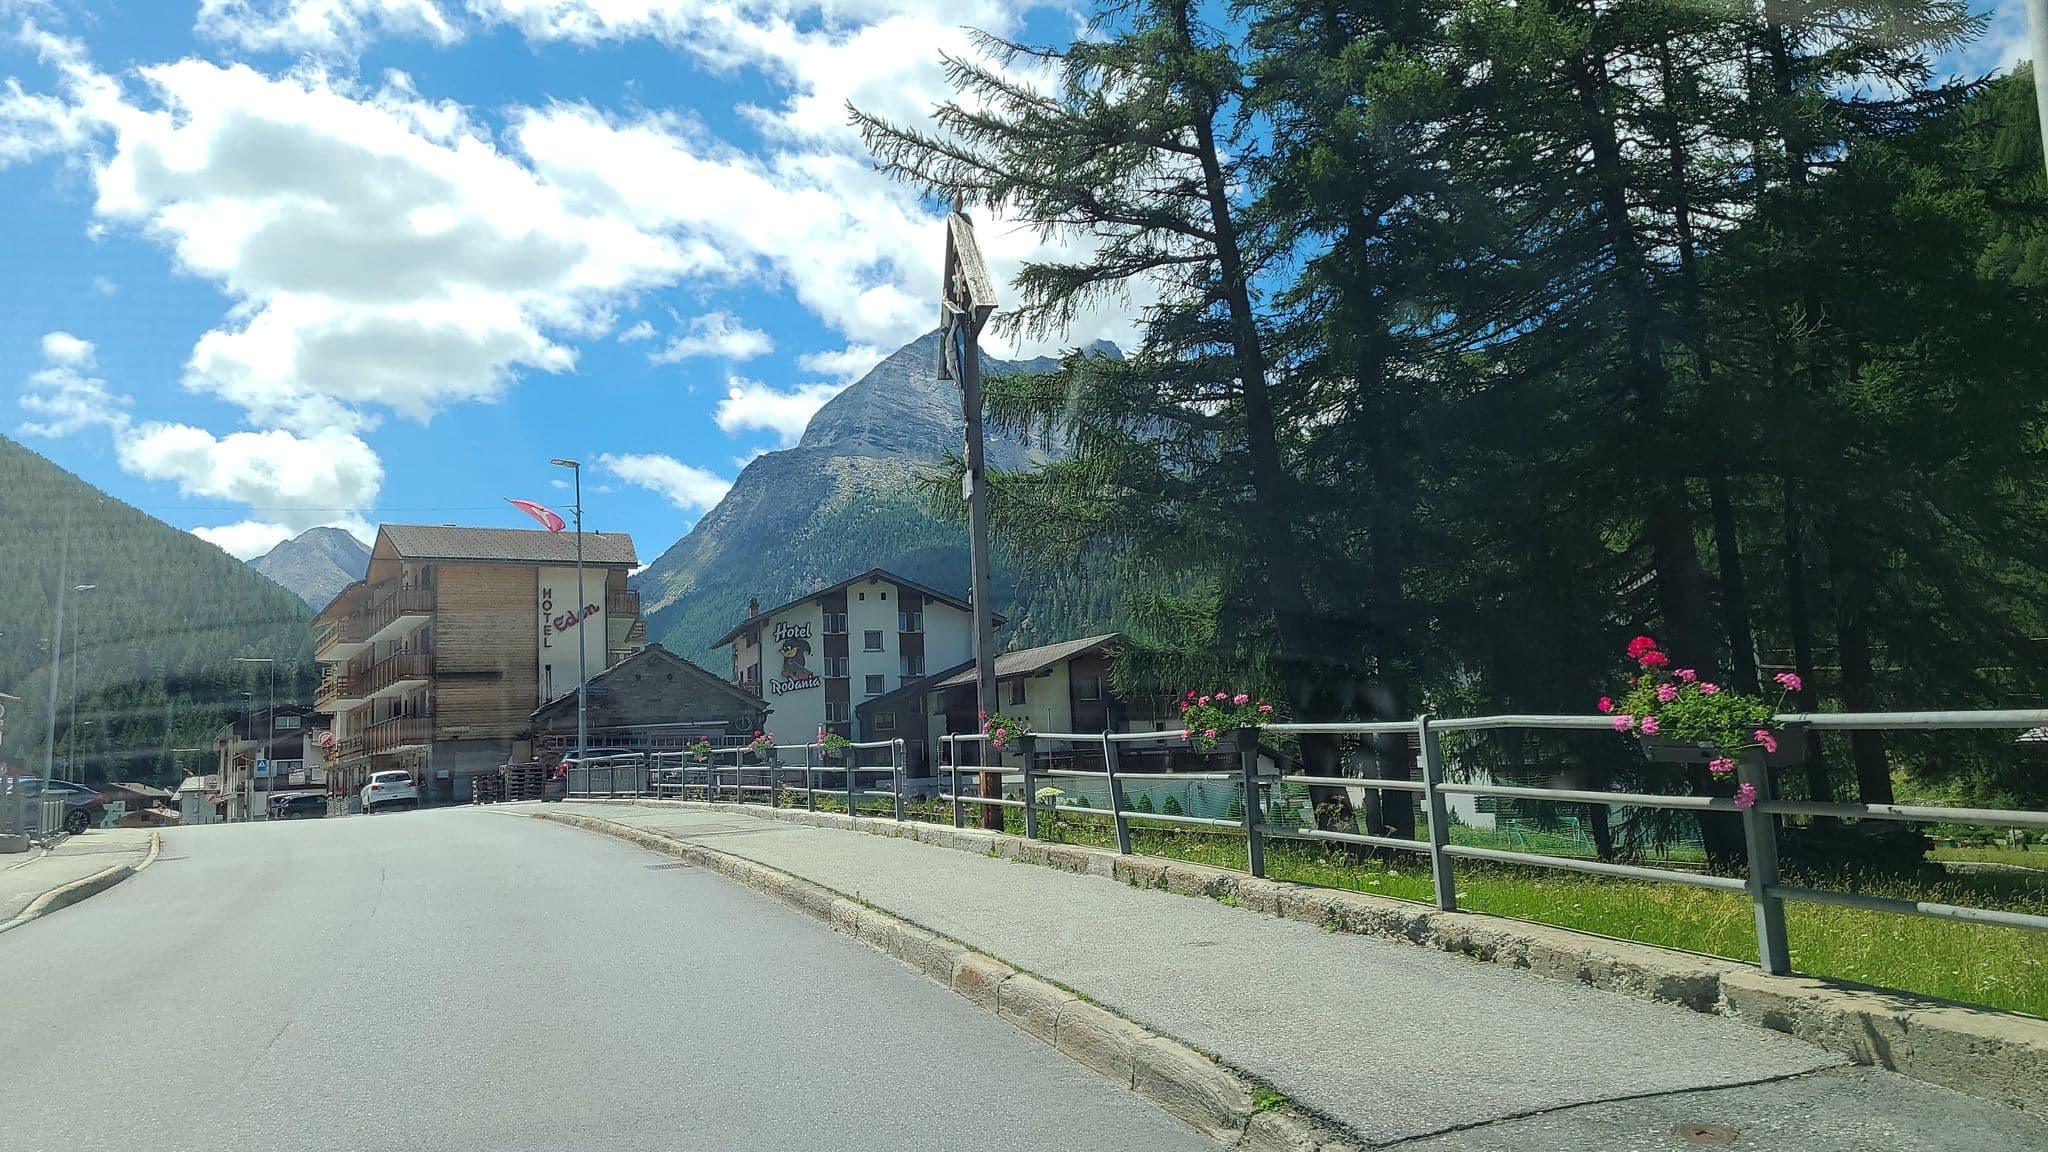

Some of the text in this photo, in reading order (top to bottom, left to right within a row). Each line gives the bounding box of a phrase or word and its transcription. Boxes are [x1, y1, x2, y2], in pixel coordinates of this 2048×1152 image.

[543, 588, 553, 648] HOTEL
[774, 621, 813, 643] Hotel
[770, 674, 823, 696] Rodania
